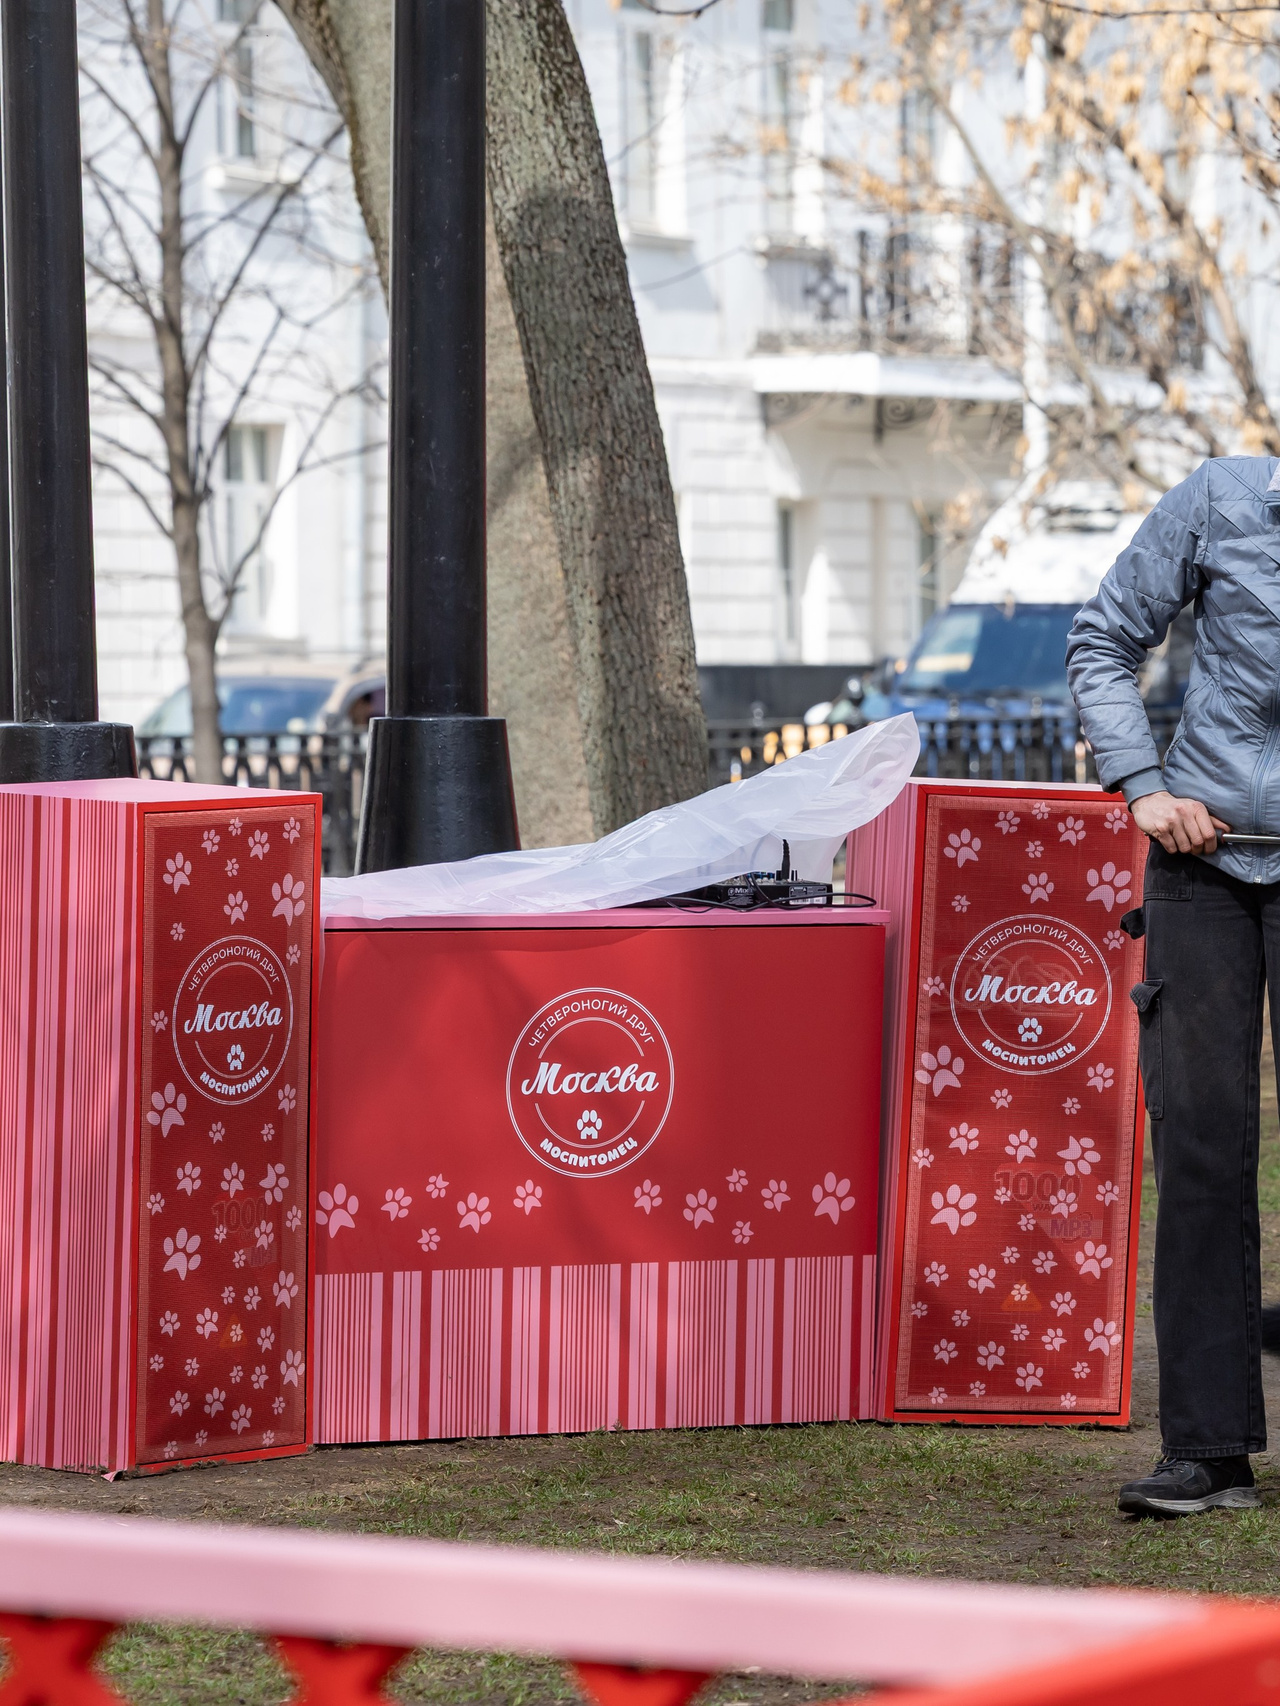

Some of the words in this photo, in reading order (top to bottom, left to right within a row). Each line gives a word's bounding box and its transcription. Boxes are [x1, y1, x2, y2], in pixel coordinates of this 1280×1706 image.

[972, 924, 1068, 962] ЧЕТВЕРОНОГИЙ
[1066, 938, 1094, 965] ДРУГ
[188, 946, 261, 992] ЧЕТВЕРОНОГИЙ
[259, 957, 280, 983] ДРУГ
[964, 974, 1098, 1007] Москва
[184, 1001, 283, 1034] Москва
[528, 999, 629, 1047] ЧЕТВЕРОНОГИЙ
[626, 1014, 655, 1044] ДРУГ
[981, 1039, 1077, 1066] МОСПИТОМЕЦ
[199, 1066, 270, 1096] МОСПИТОМЕЦ
[521, 1061, 660, 1096] Москва
[539, 1137, 639, 1168] МОСПИТОМЕЦ
